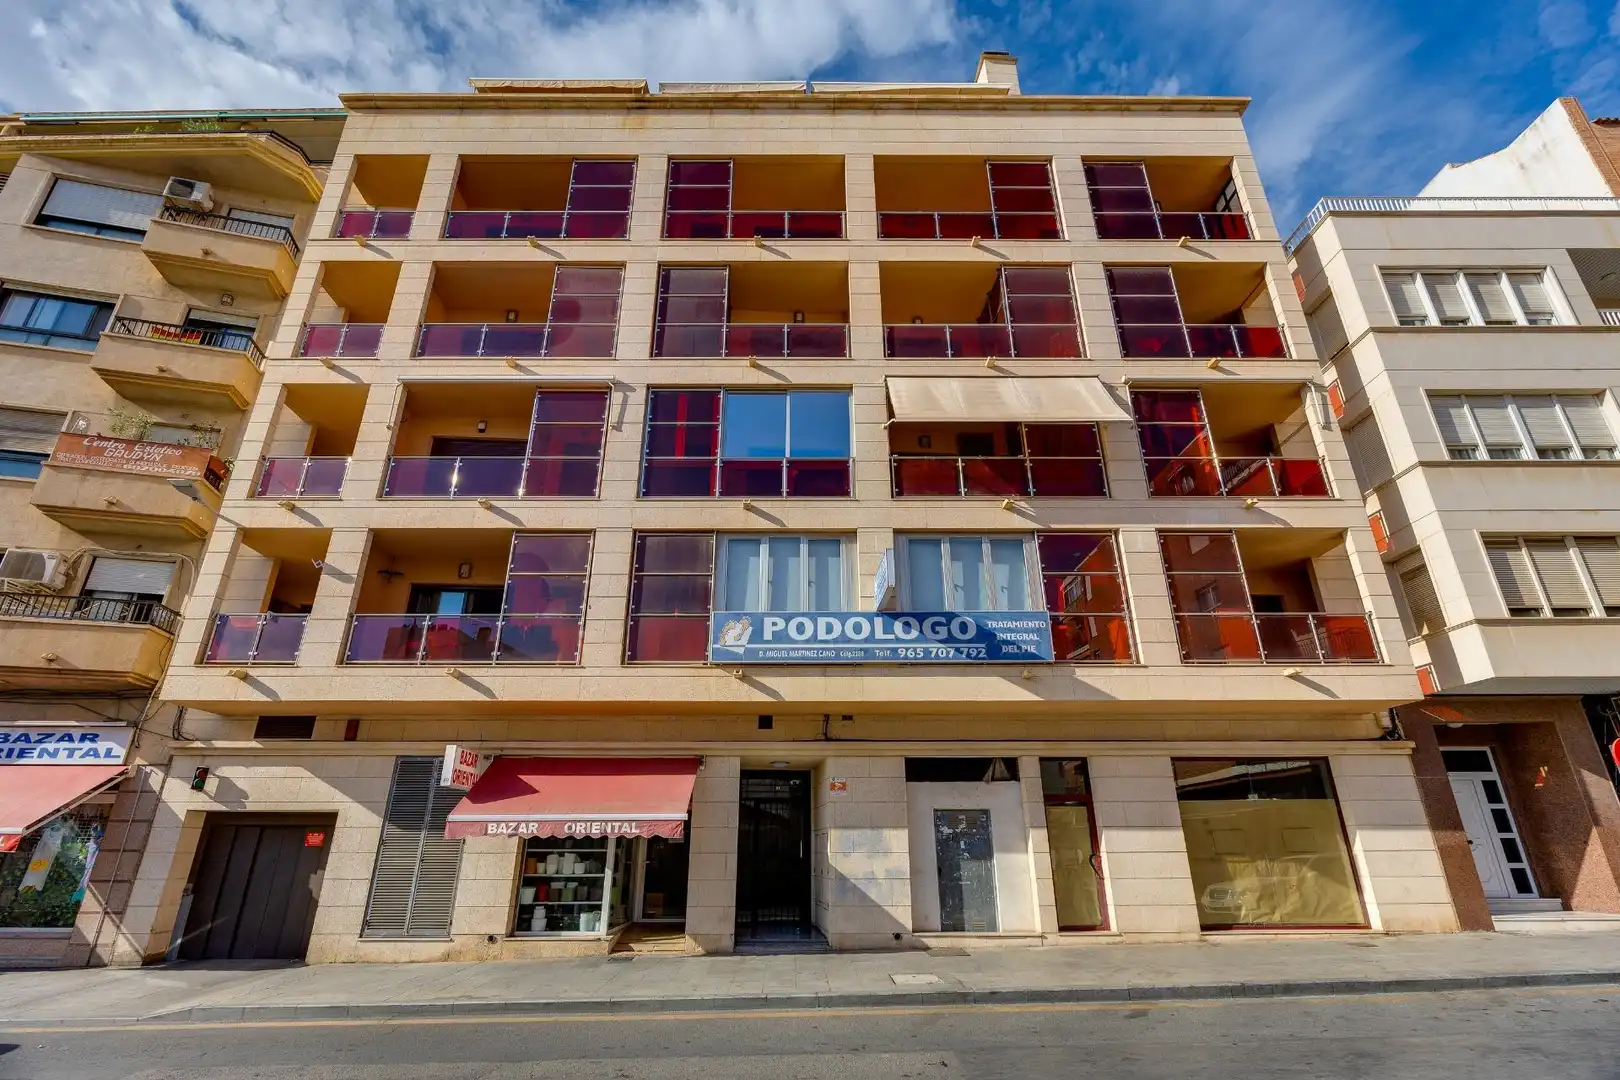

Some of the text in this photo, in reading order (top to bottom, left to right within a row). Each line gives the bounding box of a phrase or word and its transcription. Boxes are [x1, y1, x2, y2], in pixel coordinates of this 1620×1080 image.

[83, 436, 126, 449] Centro
[763, 616, 977, 641] PODOLOGO
[874, 648, 988, 658] Telf. 965 707 792
[1002, 644, 1037, 653] DEL PIE
[0, 732, 100, 744] BAZAR
[460, 750, 479, 769] BAZAR
[487, 822, 640, 834] BAZAR ORIENTAL
